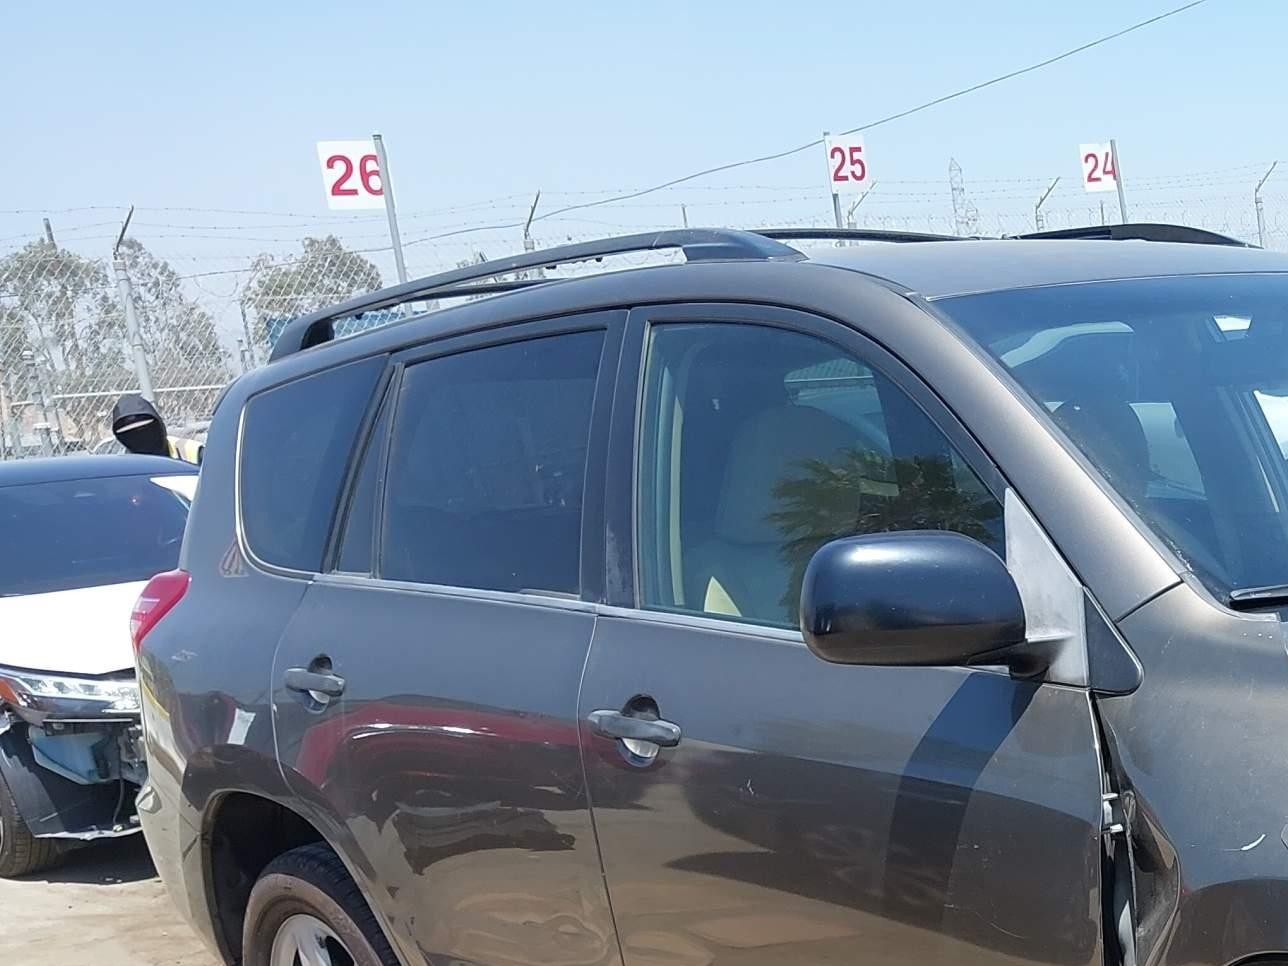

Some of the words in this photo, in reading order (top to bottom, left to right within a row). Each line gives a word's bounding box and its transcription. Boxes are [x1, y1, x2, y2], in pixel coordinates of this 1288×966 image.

[327, 154, 385, 196] 26
[830, 146, 866, 182] 25
[1084, 152, 1117, 183] 24
